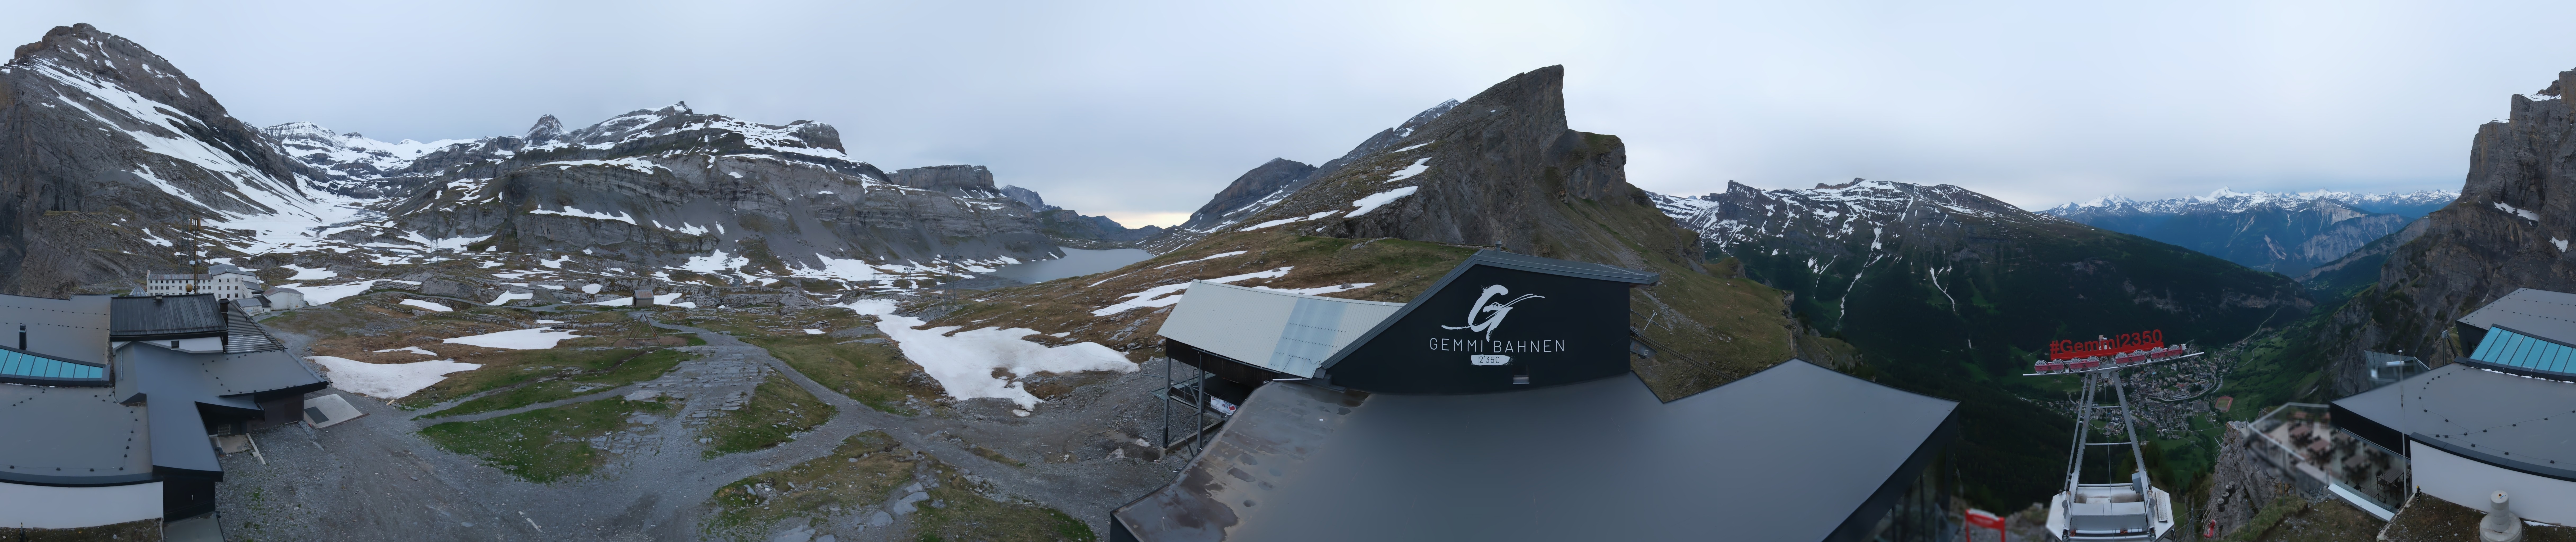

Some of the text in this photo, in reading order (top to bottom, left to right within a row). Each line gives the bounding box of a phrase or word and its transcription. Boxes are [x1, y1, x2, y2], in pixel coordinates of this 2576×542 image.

[1430, 338, 1564, 353] GEMMI BAHNEN
[2050, 329, 2162, 354] #Gemmi2350
